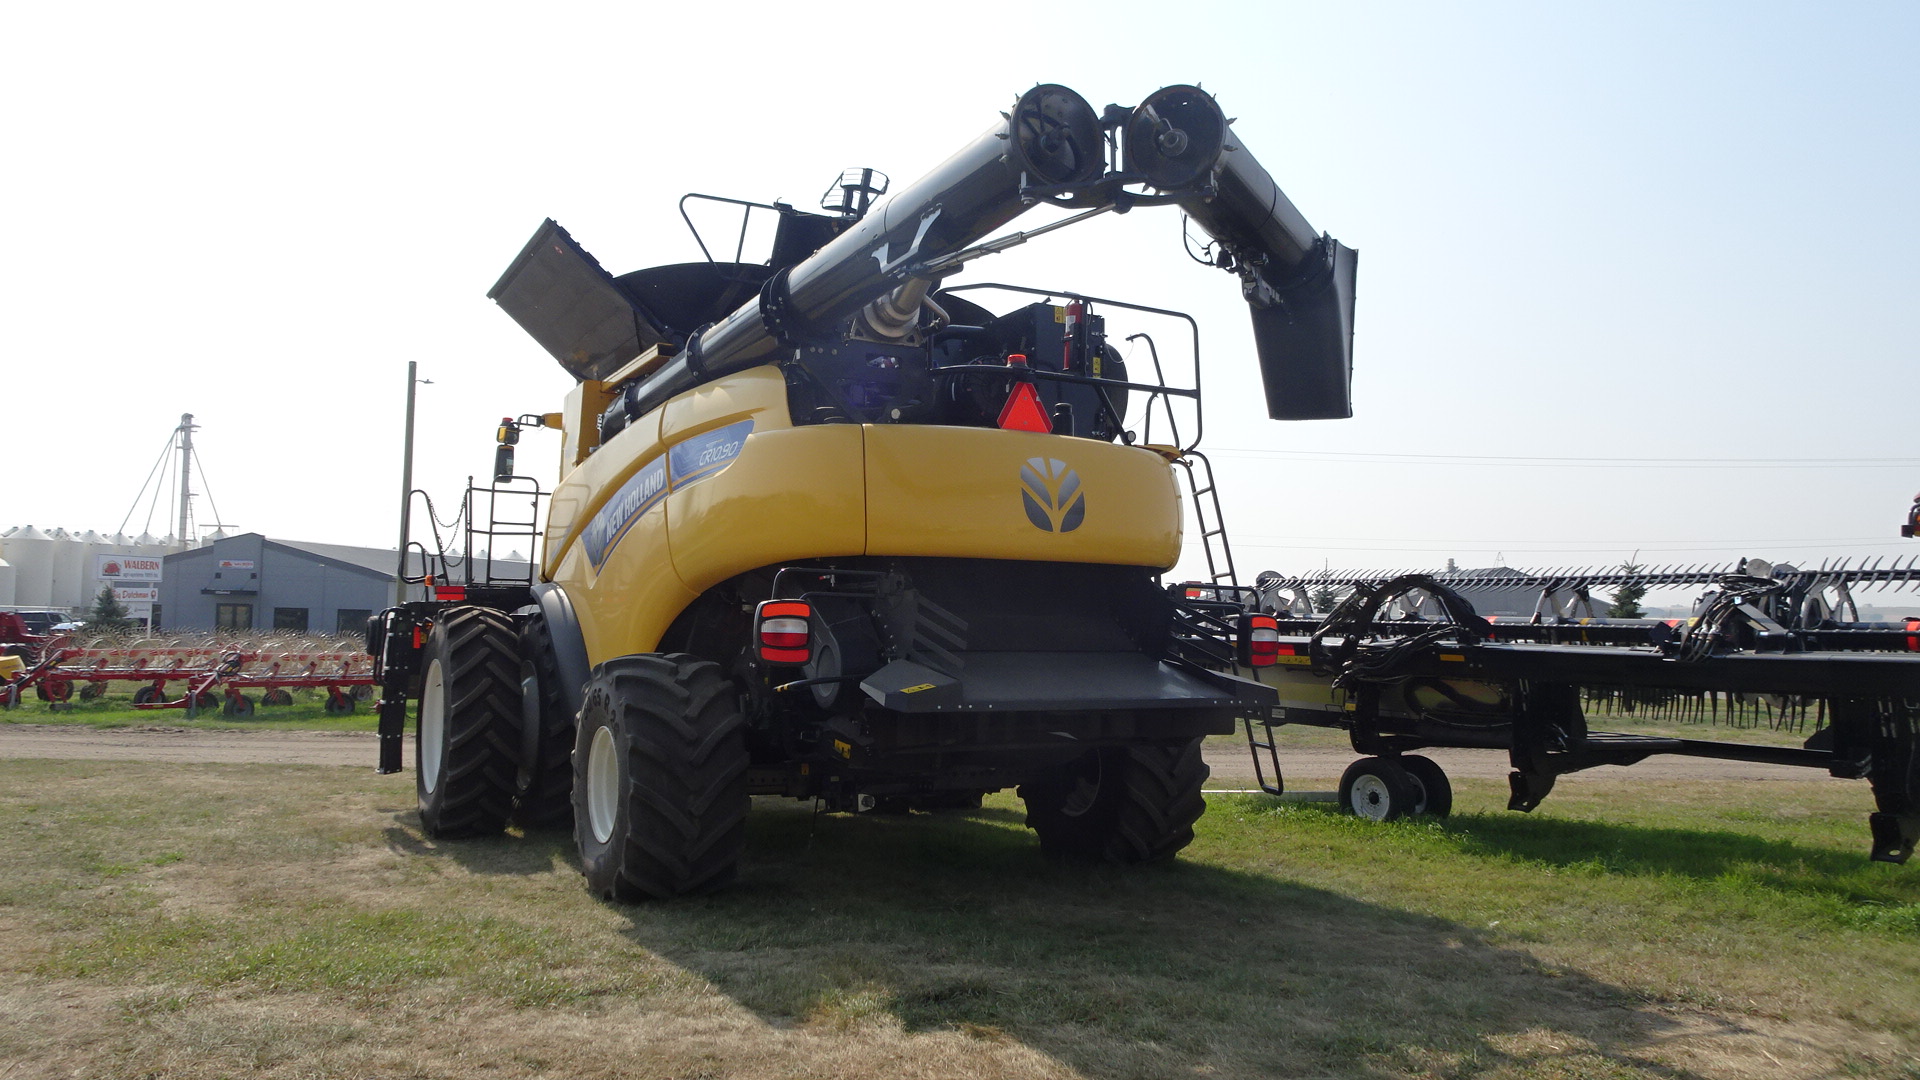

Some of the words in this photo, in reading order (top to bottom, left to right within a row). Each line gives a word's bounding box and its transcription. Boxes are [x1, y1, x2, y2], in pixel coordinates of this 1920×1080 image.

[699, 441, 739, 466] CR10.90
[606, 503, 625, 543] NEW
[624, 468, 664, 520] HOLLAND
[123, 560, 160, 570] WALBERN
